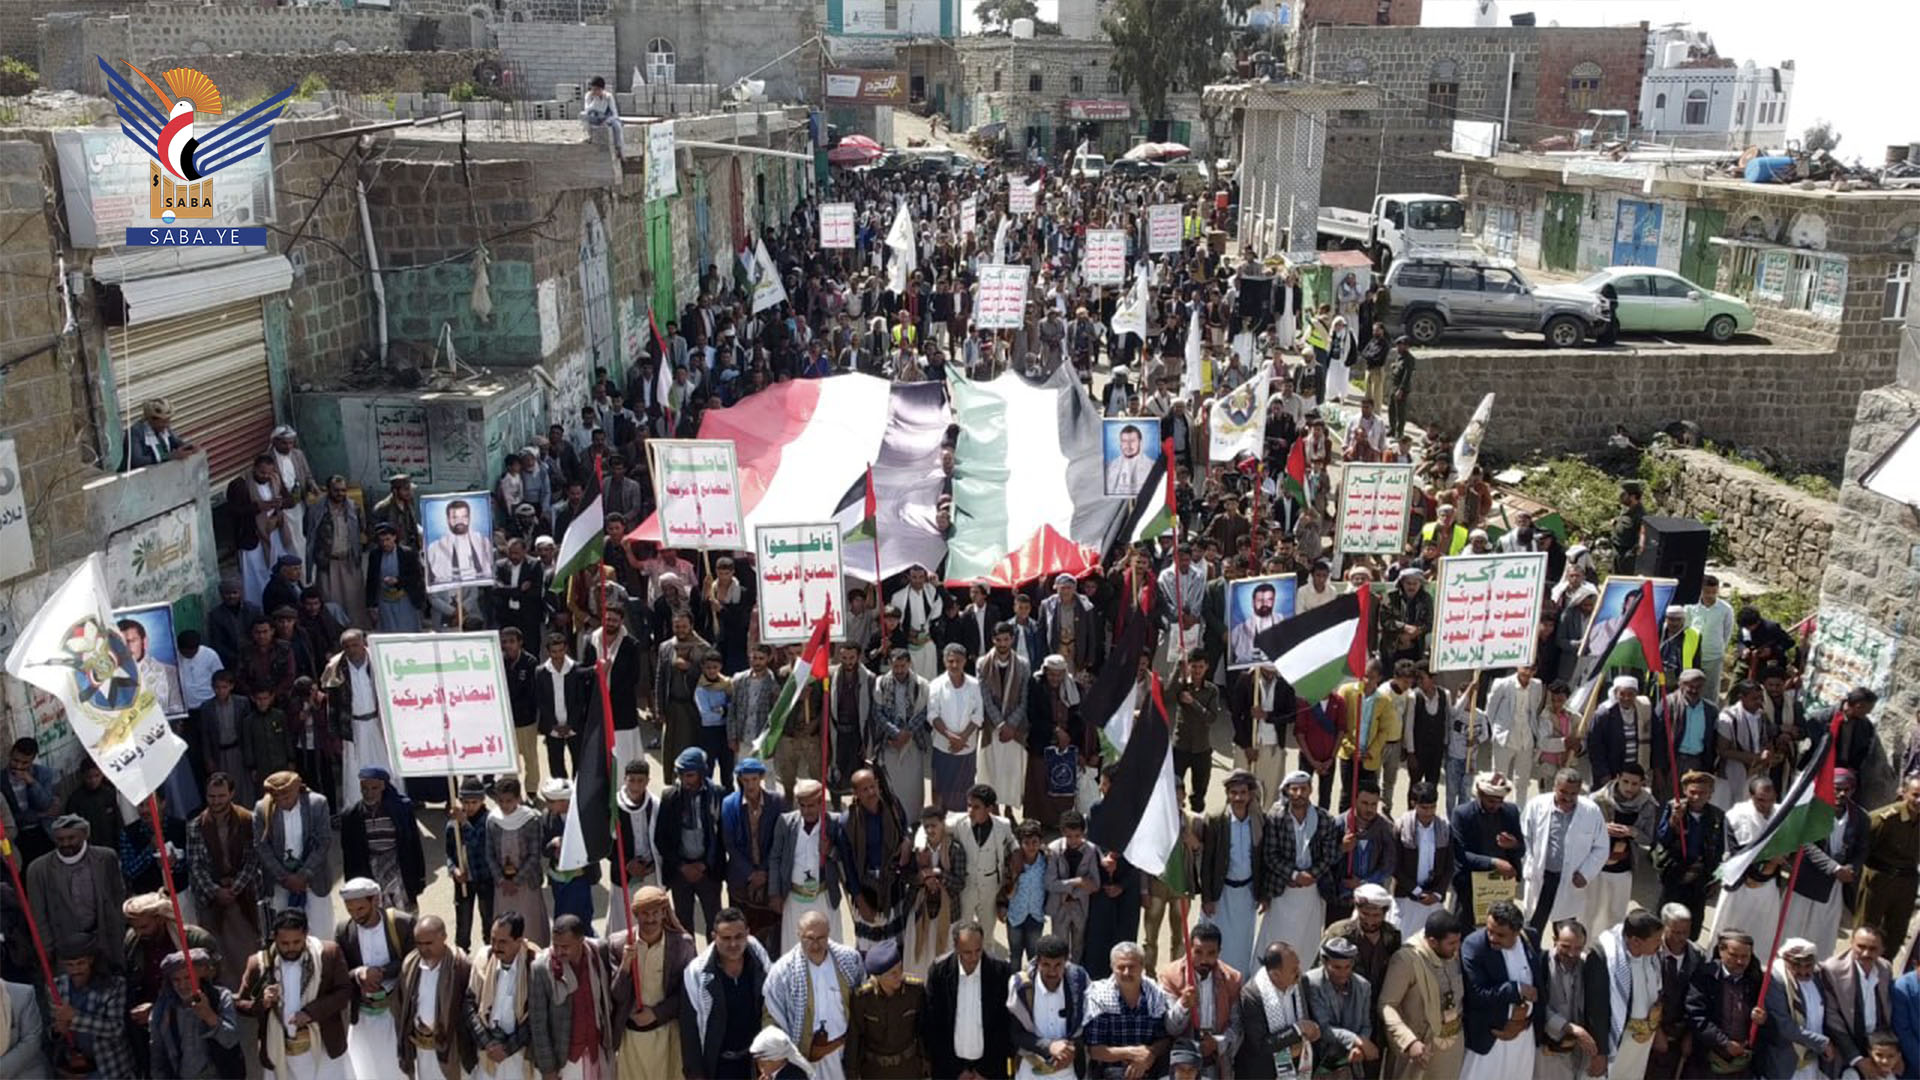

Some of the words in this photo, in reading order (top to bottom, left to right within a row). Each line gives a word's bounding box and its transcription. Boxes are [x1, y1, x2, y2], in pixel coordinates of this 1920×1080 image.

[1386, 474, 1407, 485] الله
[1503, 562, 1537, 579] الله
[1495, 586, 1534, 603] الموت
[1493, 606, 1532, 622] الموت
[1486, 642, 1528, 665] النصر
[387, 650, 490, 680] قاطعوا
[449, 684, 495, 707] البضائع
[443, 712, 451, 730] و
